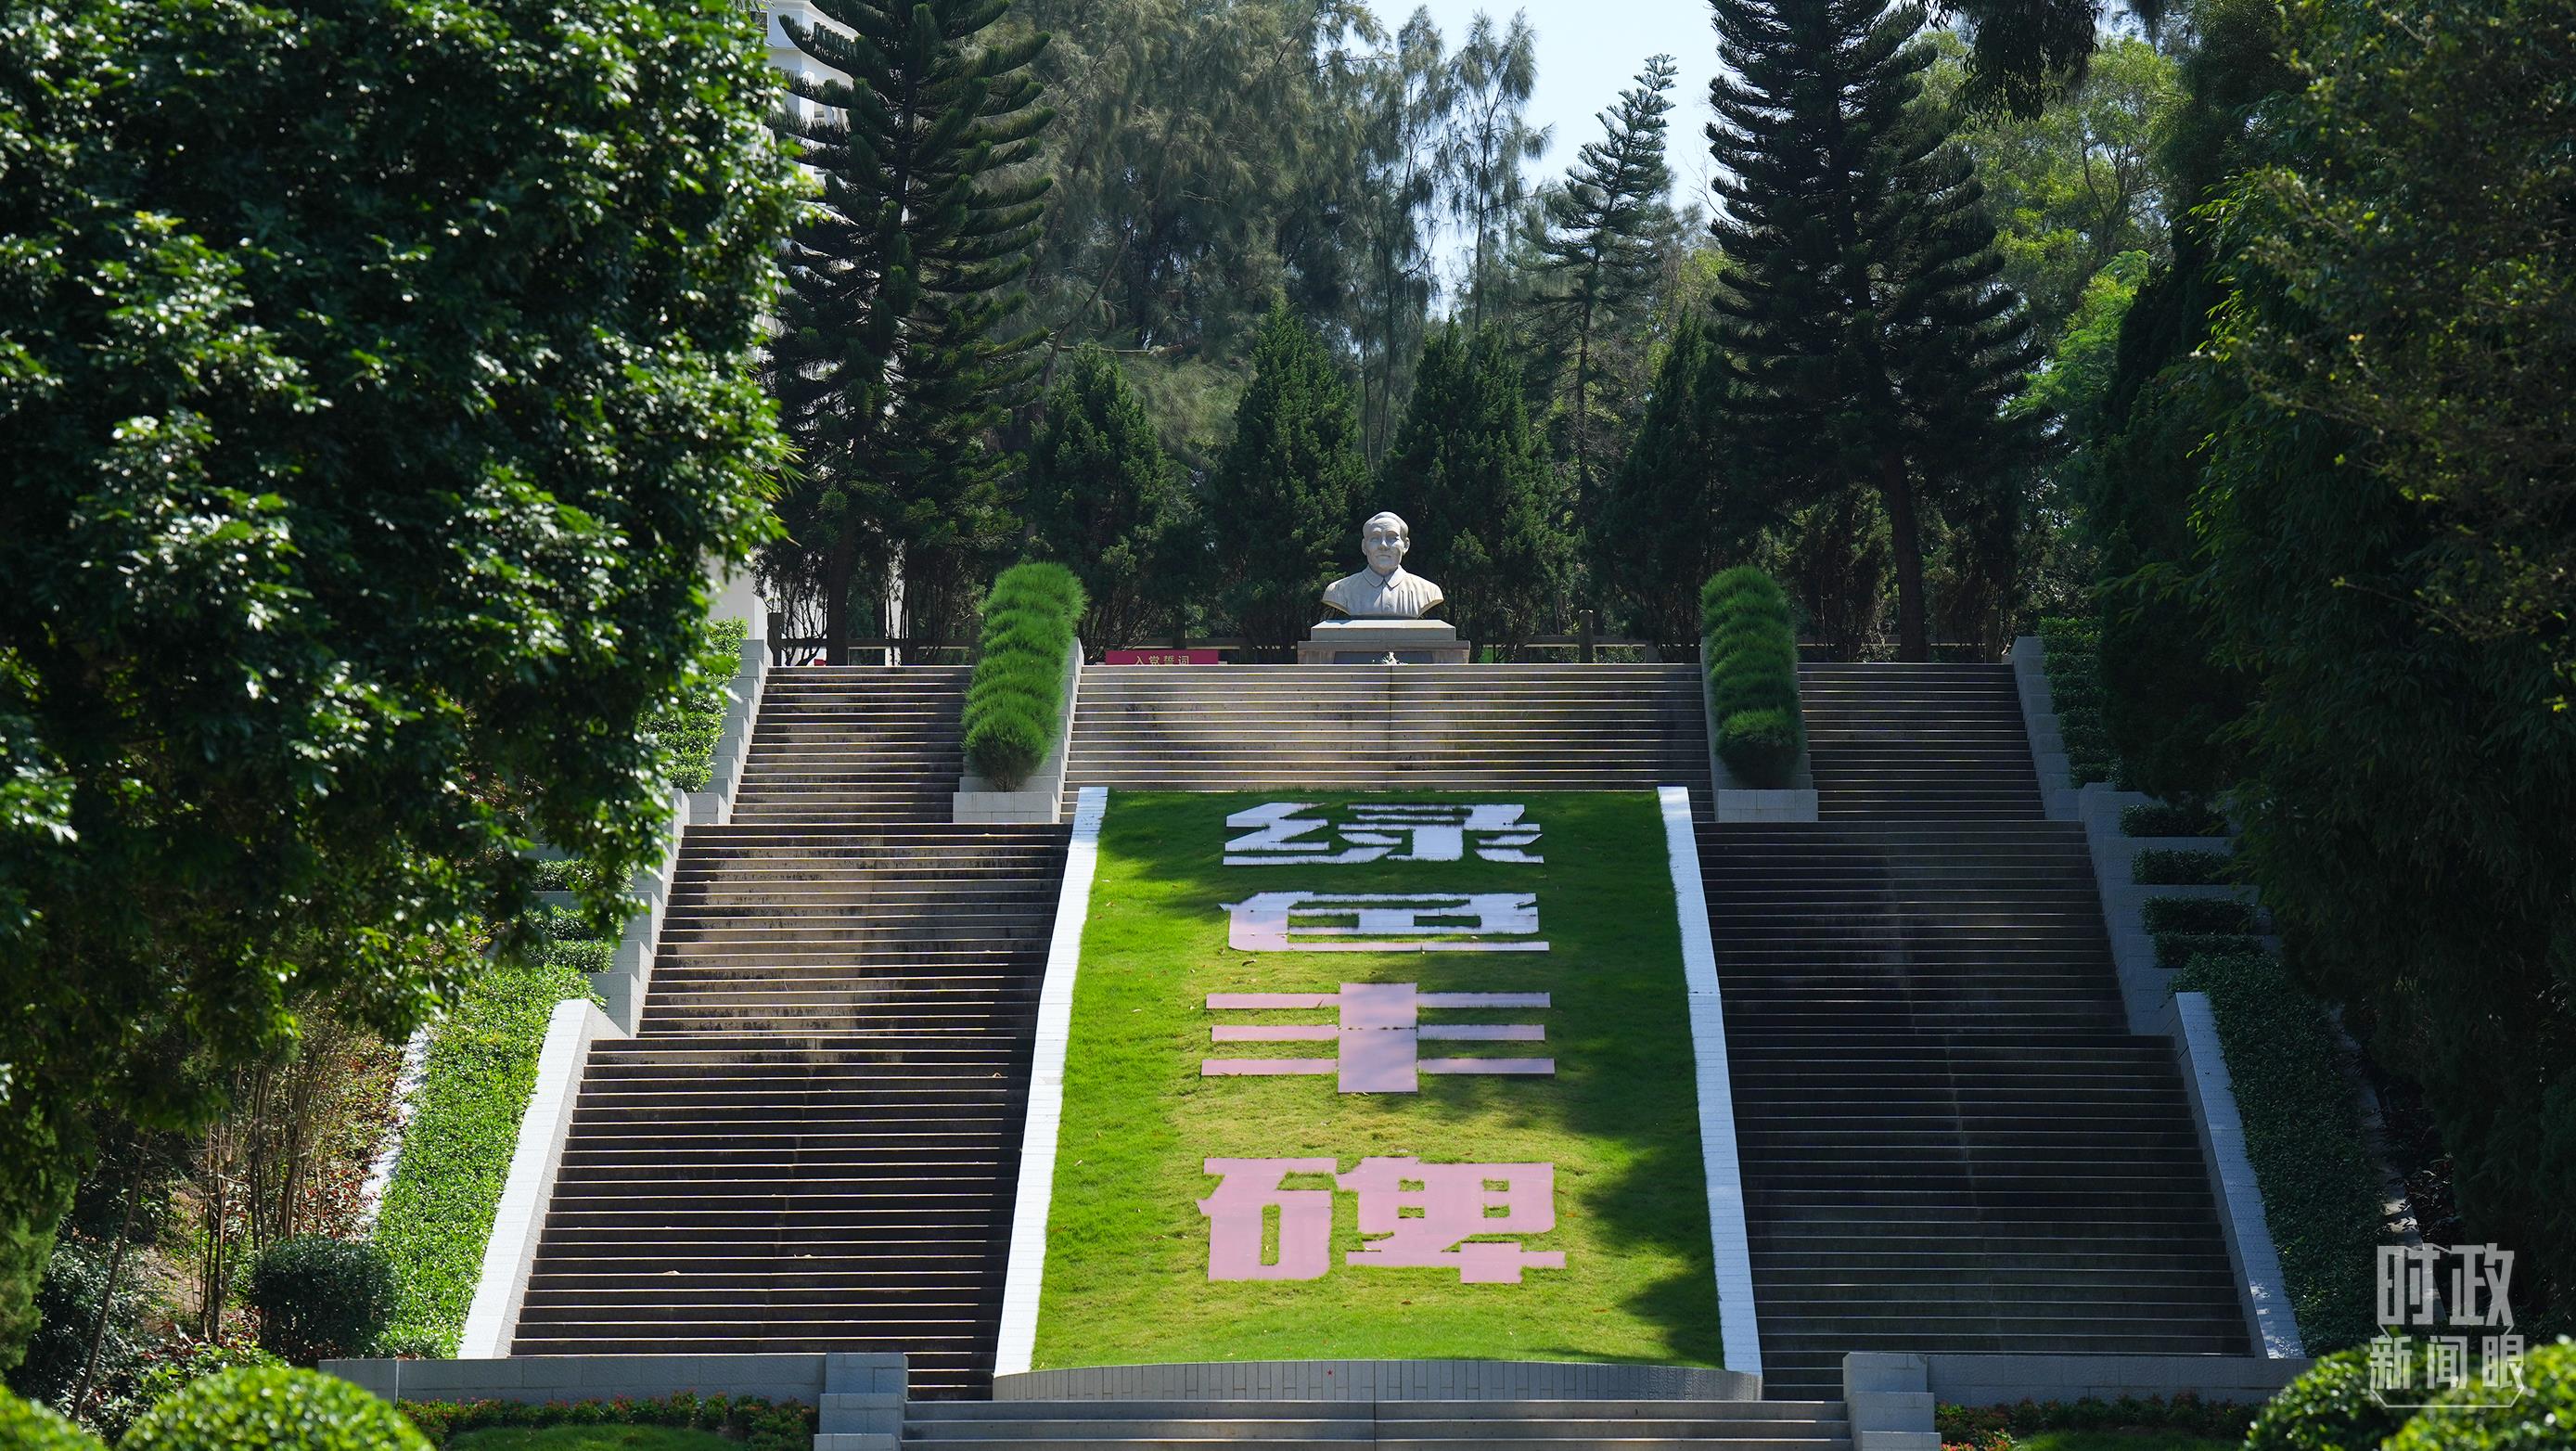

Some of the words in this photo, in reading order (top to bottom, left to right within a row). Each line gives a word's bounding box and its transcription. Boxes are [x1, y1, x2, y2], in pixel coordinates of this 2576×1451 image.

[1135, 655, 1189, 665] 入党誓词
[1197, 802, 1566, 1283] 绿色丰碑
